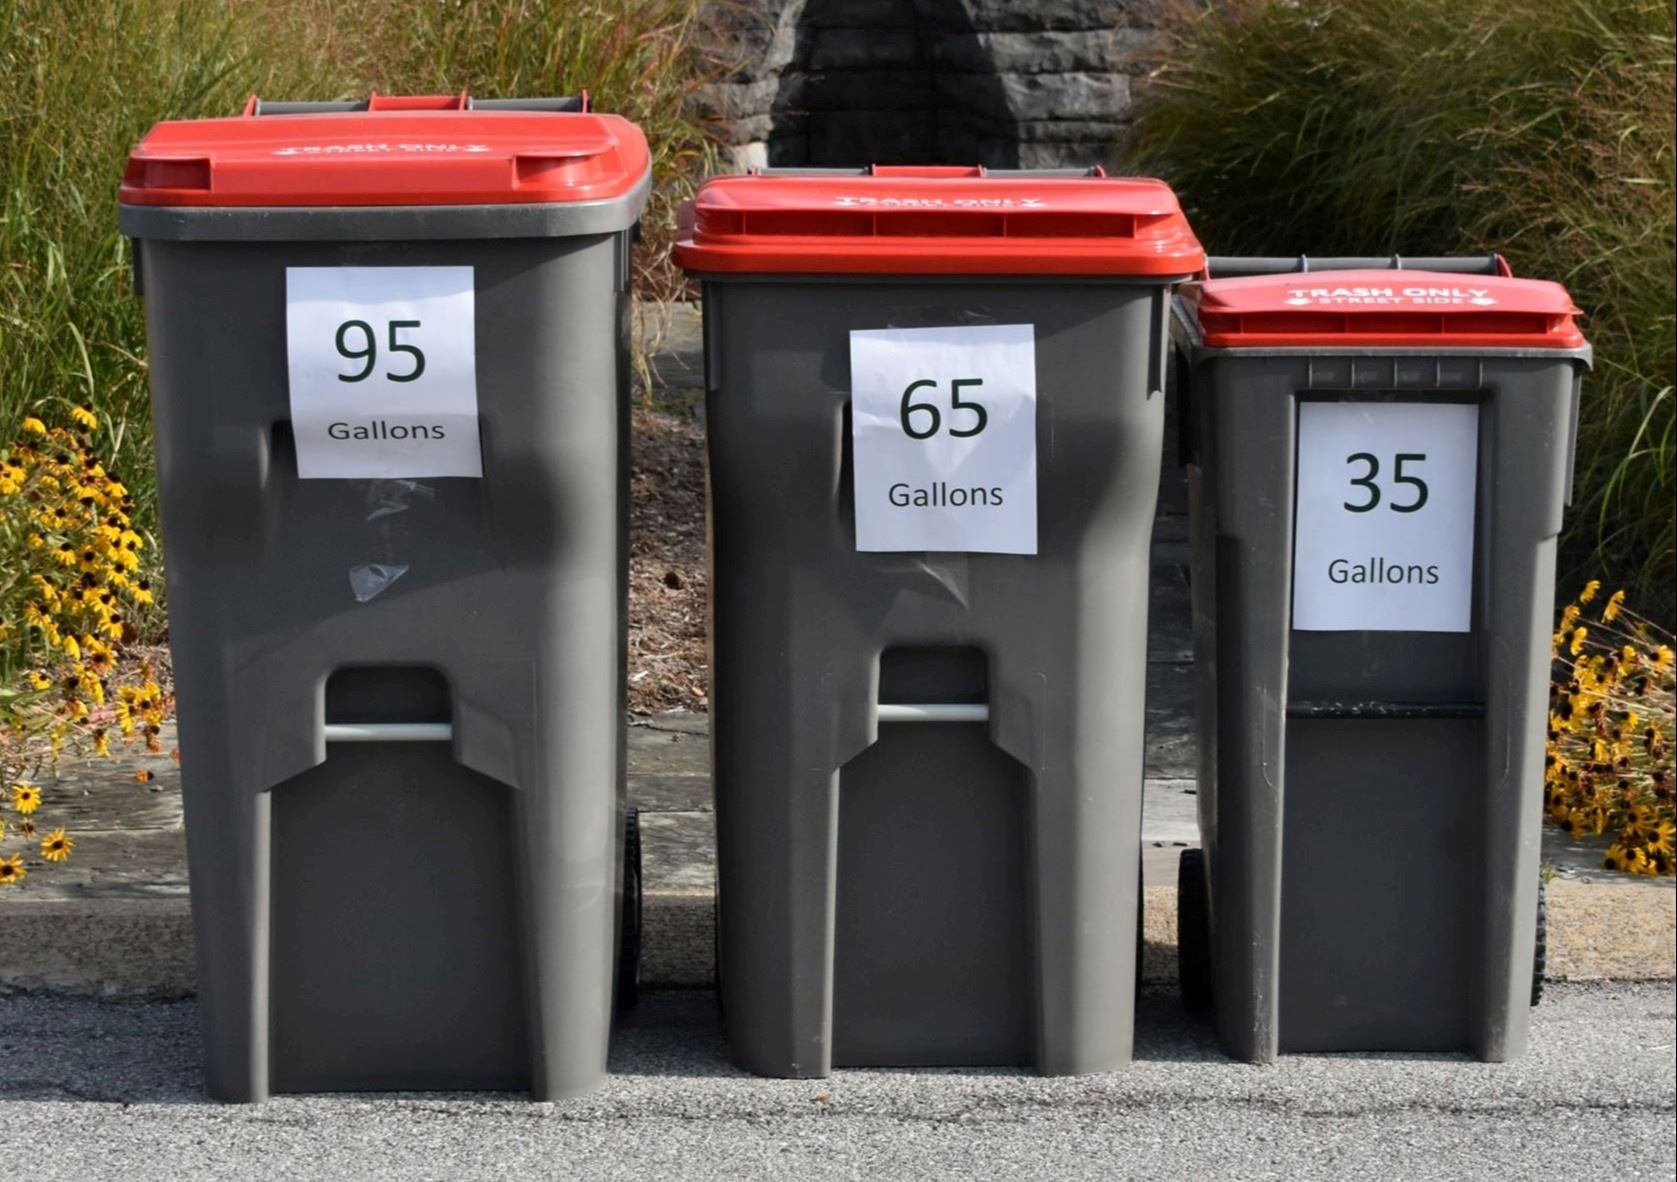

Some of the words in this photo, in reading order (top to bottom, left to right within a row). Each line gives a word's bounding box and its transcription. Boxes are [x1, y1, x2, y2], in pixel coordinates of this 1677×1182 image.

[1288, 287, 1393, 298] TRASH
[1402, 287, 1489, 298] ONLY
[1318, 297, 1403, 305] STREET
[1412, 297, 1464, 305] SIDE
[335, 320, 426, 383] 95
[900, 378, 988, 440] 65
[327, 420, 446, 441] Gallons
[888, 481, 1003, 507] Gallons
[1343, 452, 1429, 513] 35
[1328, 557, 1439, 585] Gallons
